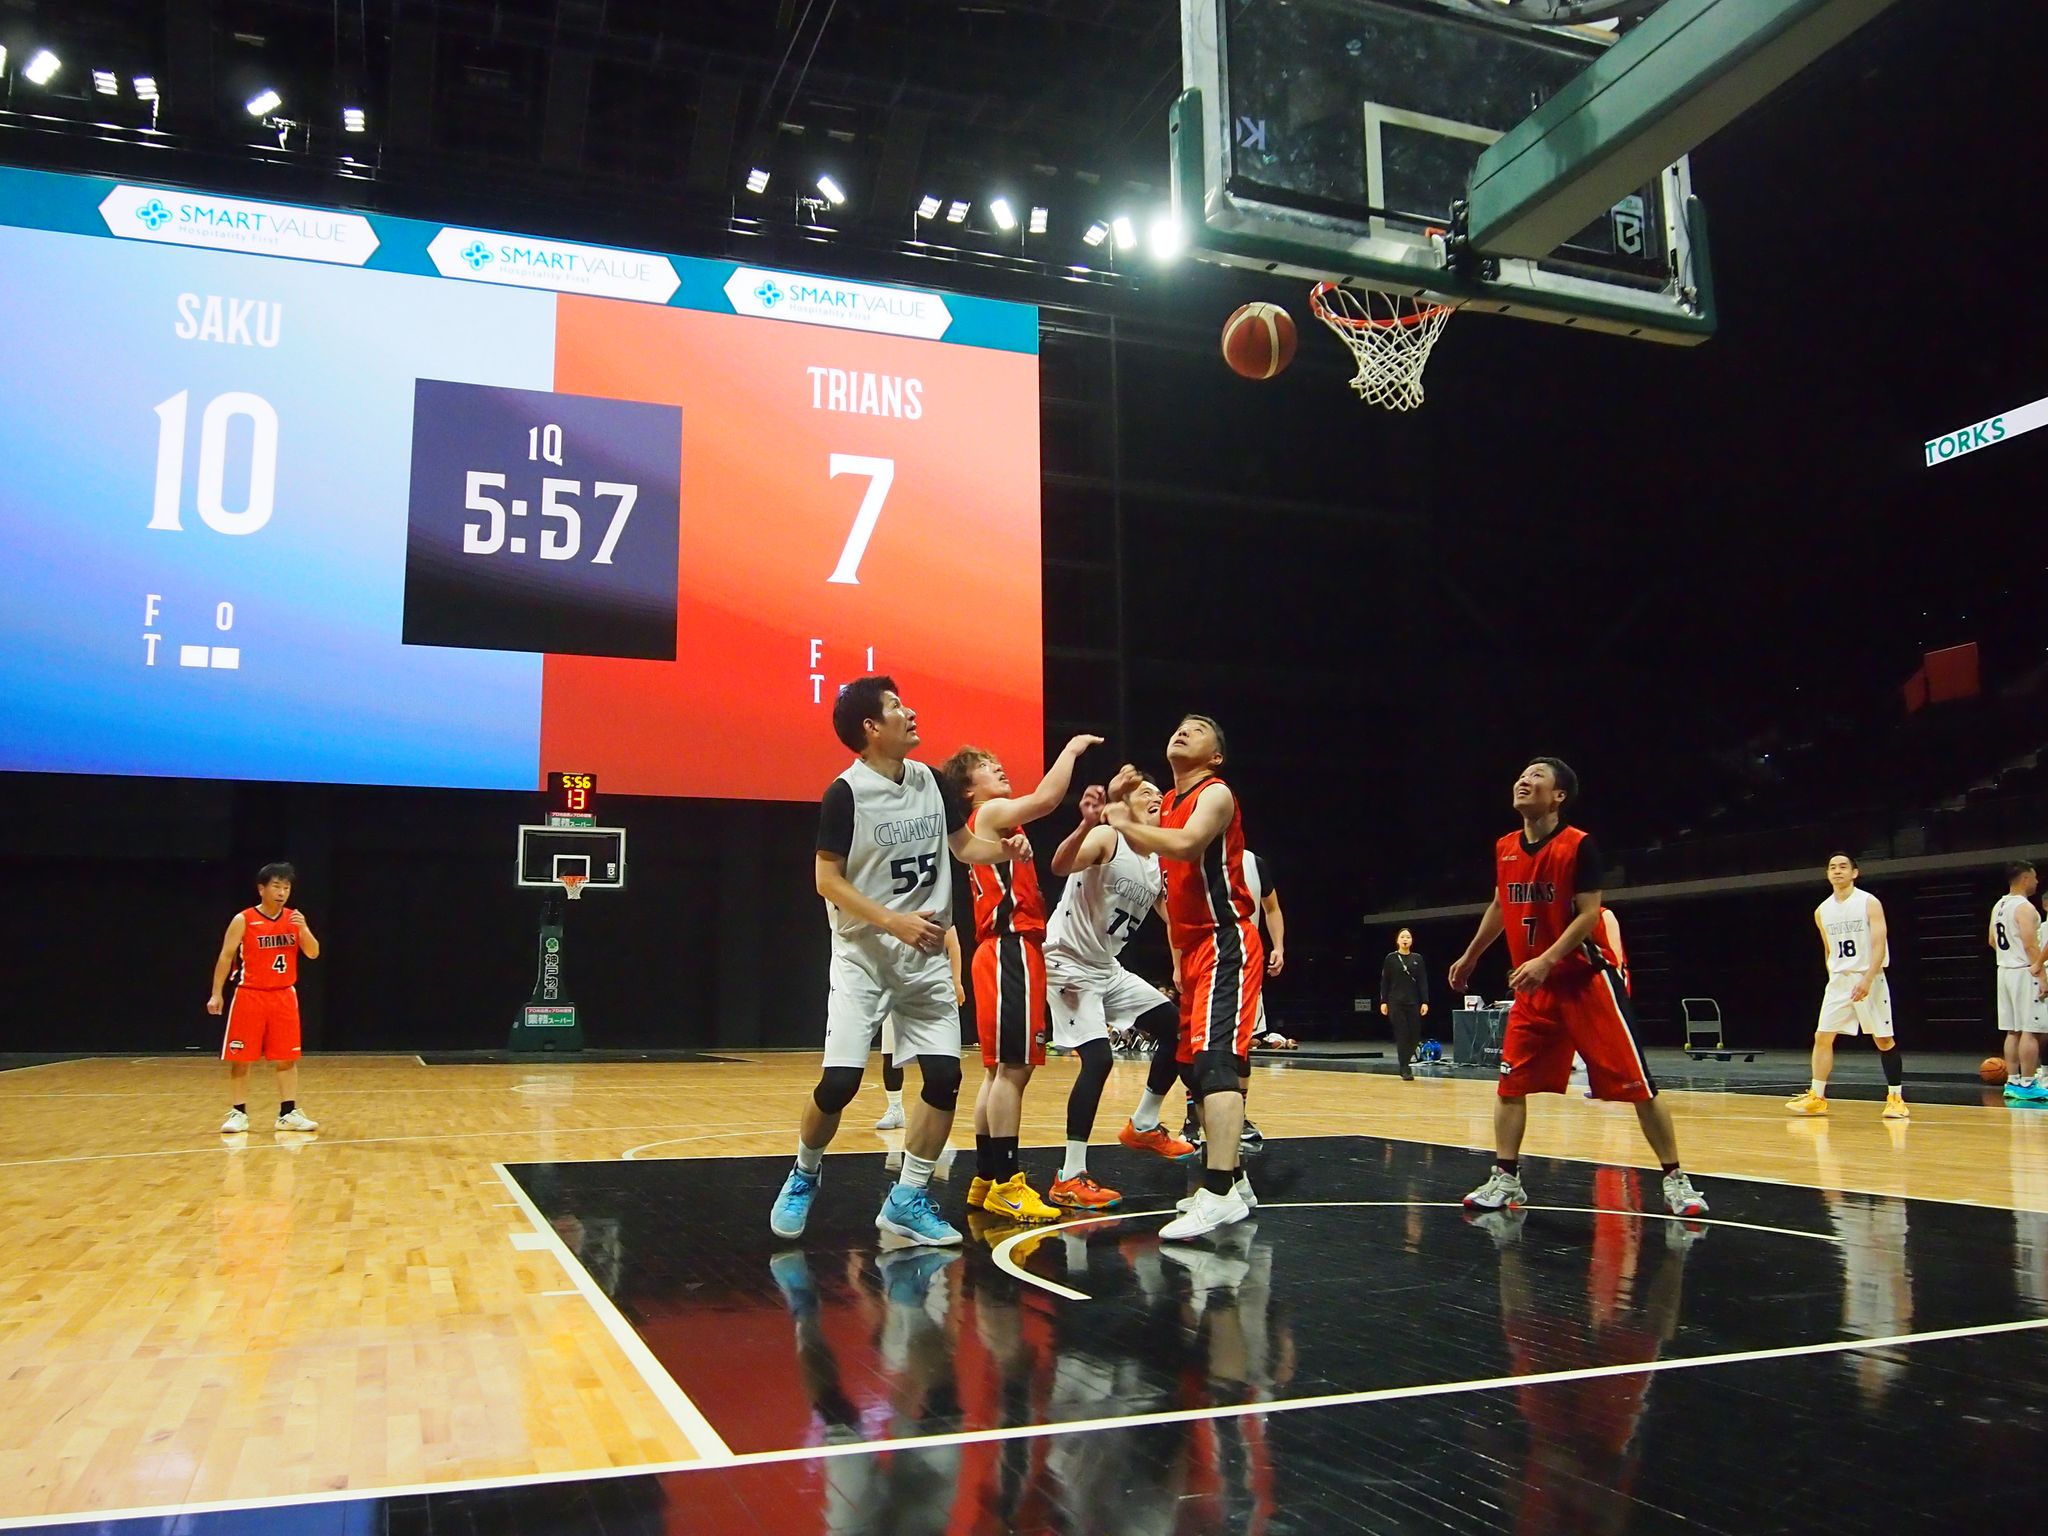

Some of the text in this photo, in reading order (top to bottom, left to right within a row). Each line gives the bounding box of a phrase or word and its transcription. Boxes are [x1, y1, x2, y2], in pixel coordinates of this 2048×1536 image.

[179, 224, 247, 243] Hospitality
[174, 292, 282, 348] SAKU
[806, 365, 924, 420] TRIANS
[527, 423, 564, 467] 1Q
[1924, 417, 2006, 465] TORKS
[146, 388, 280, 536] 10
[462, 469, 639, 565] 5:57
[825, 452, 896, 586] 7
[144, 593, 162, 627] F
[142, 633, 162, 666] T
[809, 638, 875, 672] F 1
[809, 673, 826, 704] T
[562, 775, 592, 789] 5:56
[567, 788, 585, 810] 13
[890, 851, 938, 895] 55
[1507, 882, 1556, 904] TRIANS
[256, 933, 297, 950] TRIANS
[1106, 907, 1141, 942] 75
[1521, 916, 1538, 947] 7
[271, 953, 288, 974] 4
[1838, 939, 1857, 959] 18
